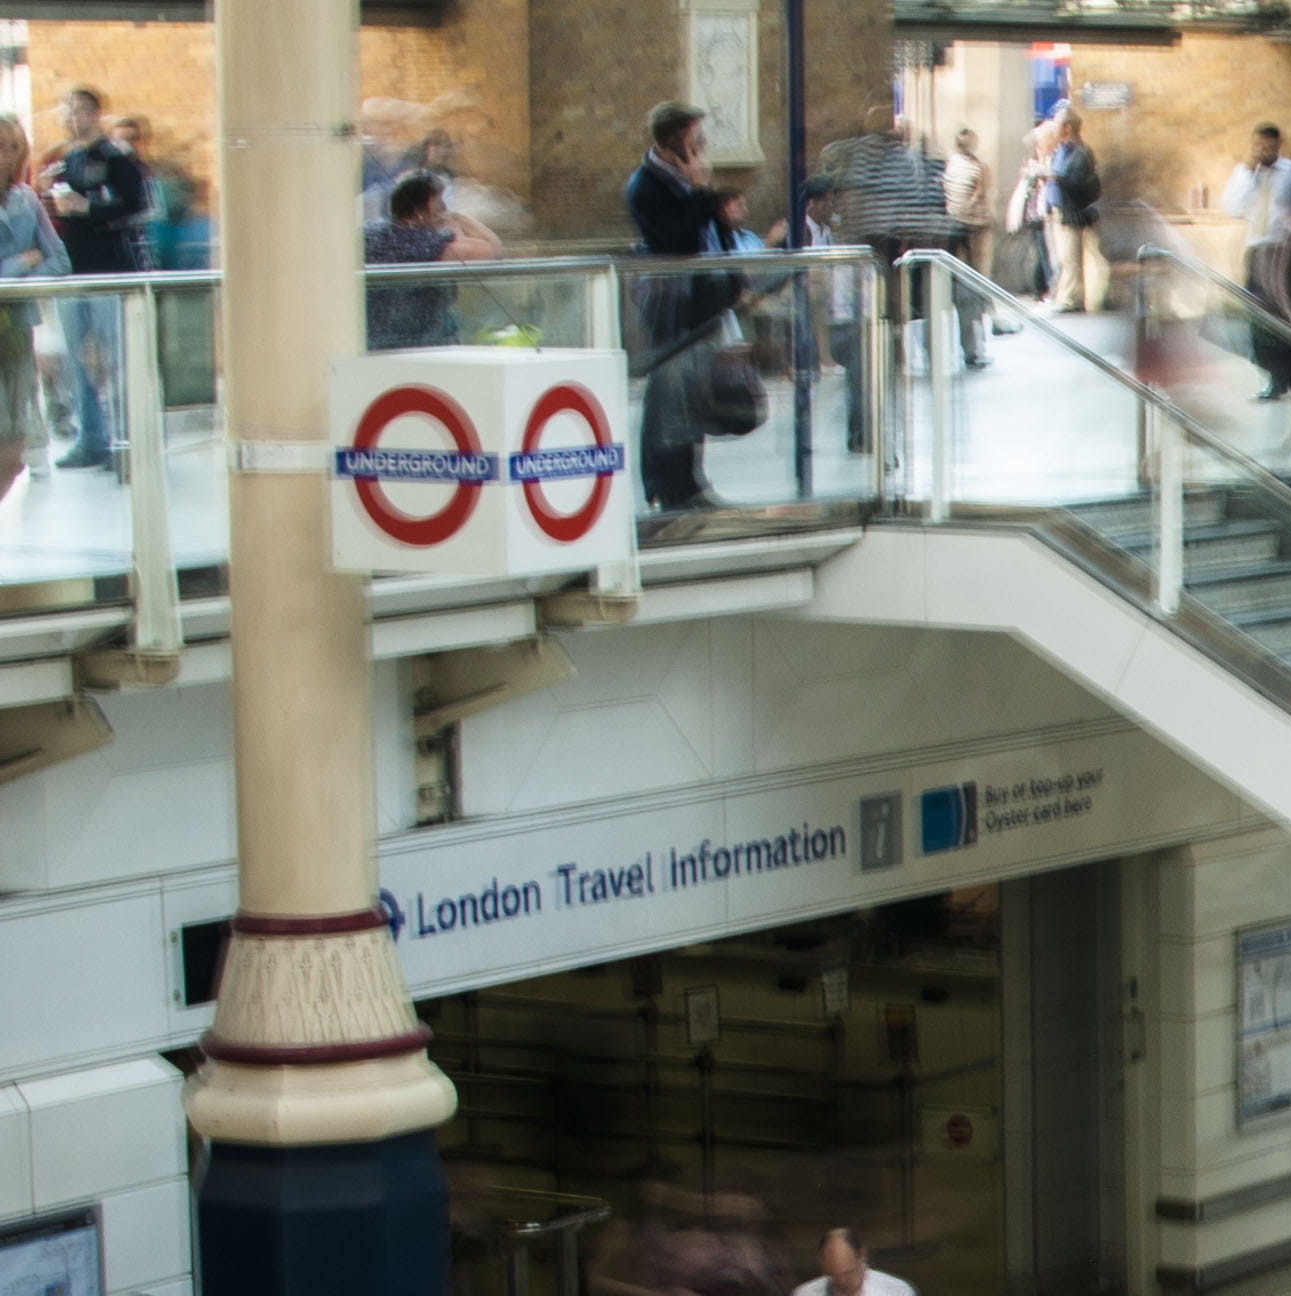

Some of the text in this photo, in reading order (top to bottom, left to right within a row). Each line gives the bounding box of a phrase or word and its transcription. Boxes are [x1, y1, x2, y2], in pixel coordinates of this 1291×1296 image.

[345, 450, 491, 475] UNDERGROUND
[515, 447, 620, 475] UNDERGROUND
[984, 806, 1030, 833] Oyster
[1032, 796, 1062, 821] card
[415, 822, 848, 937] London Travel Information
